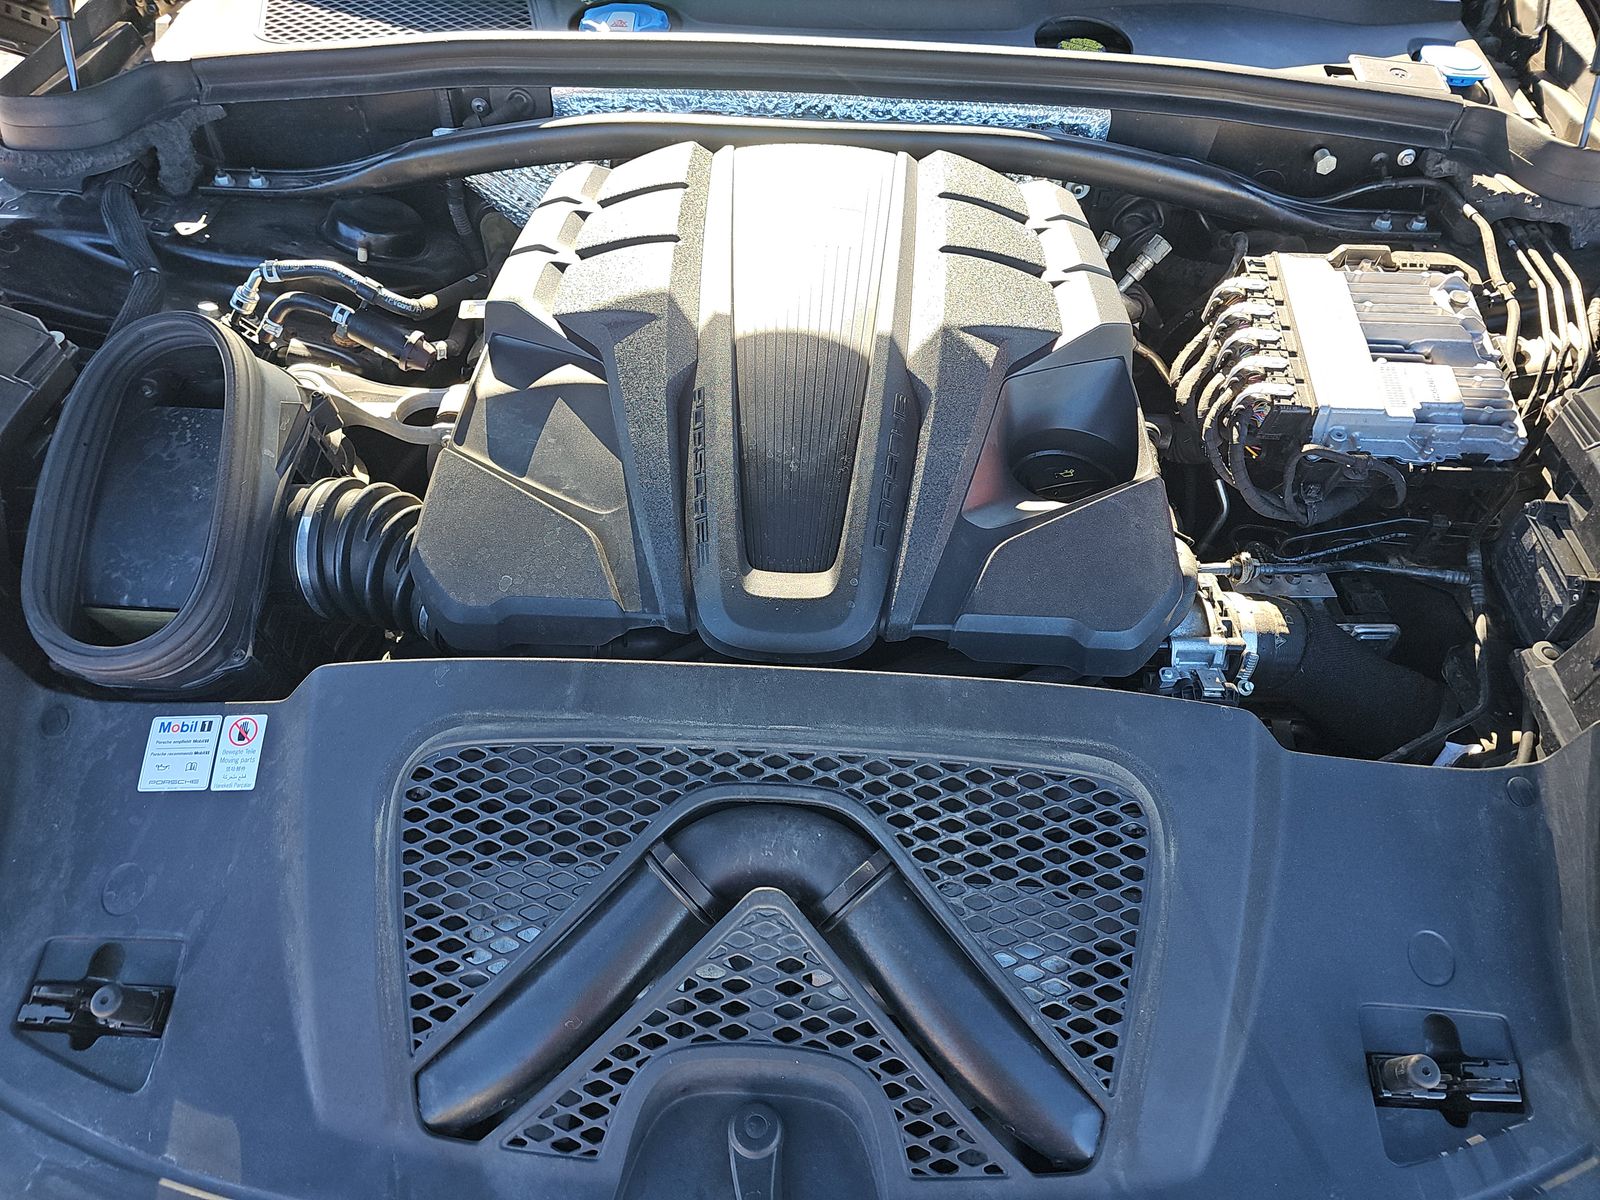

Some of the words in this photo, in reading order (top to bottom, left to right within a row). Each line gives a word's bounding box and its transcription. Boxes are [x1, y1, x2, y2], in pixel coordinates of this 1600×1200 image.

[693, 387, 709, 568] PORSCHE
[872, 392, 908, 551] PORSCHE
[159, 721, 198, 733] Mobil
[200, 720, 213, 732] 1
